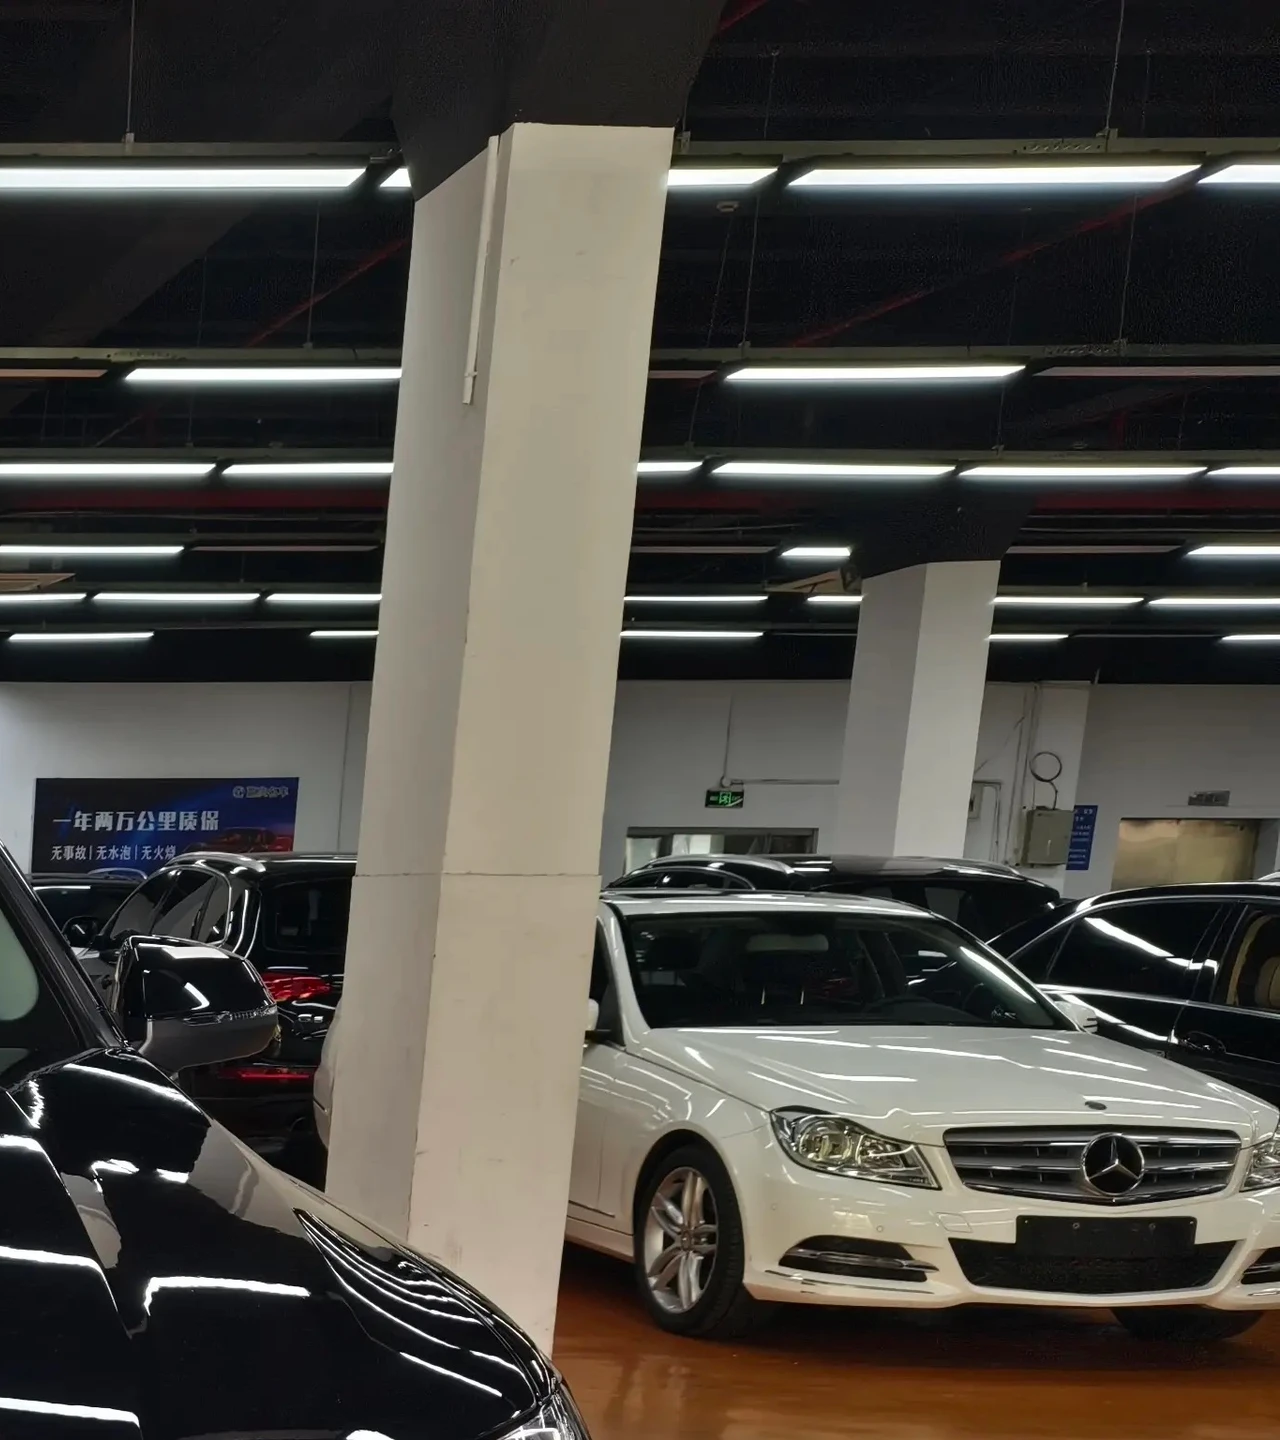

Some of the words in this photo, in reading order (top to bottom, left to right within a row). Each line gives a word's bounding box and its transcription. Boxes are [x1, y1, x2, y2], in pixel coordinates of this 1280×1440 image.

[53, 810, 220, 832] 一年两万公里质保
